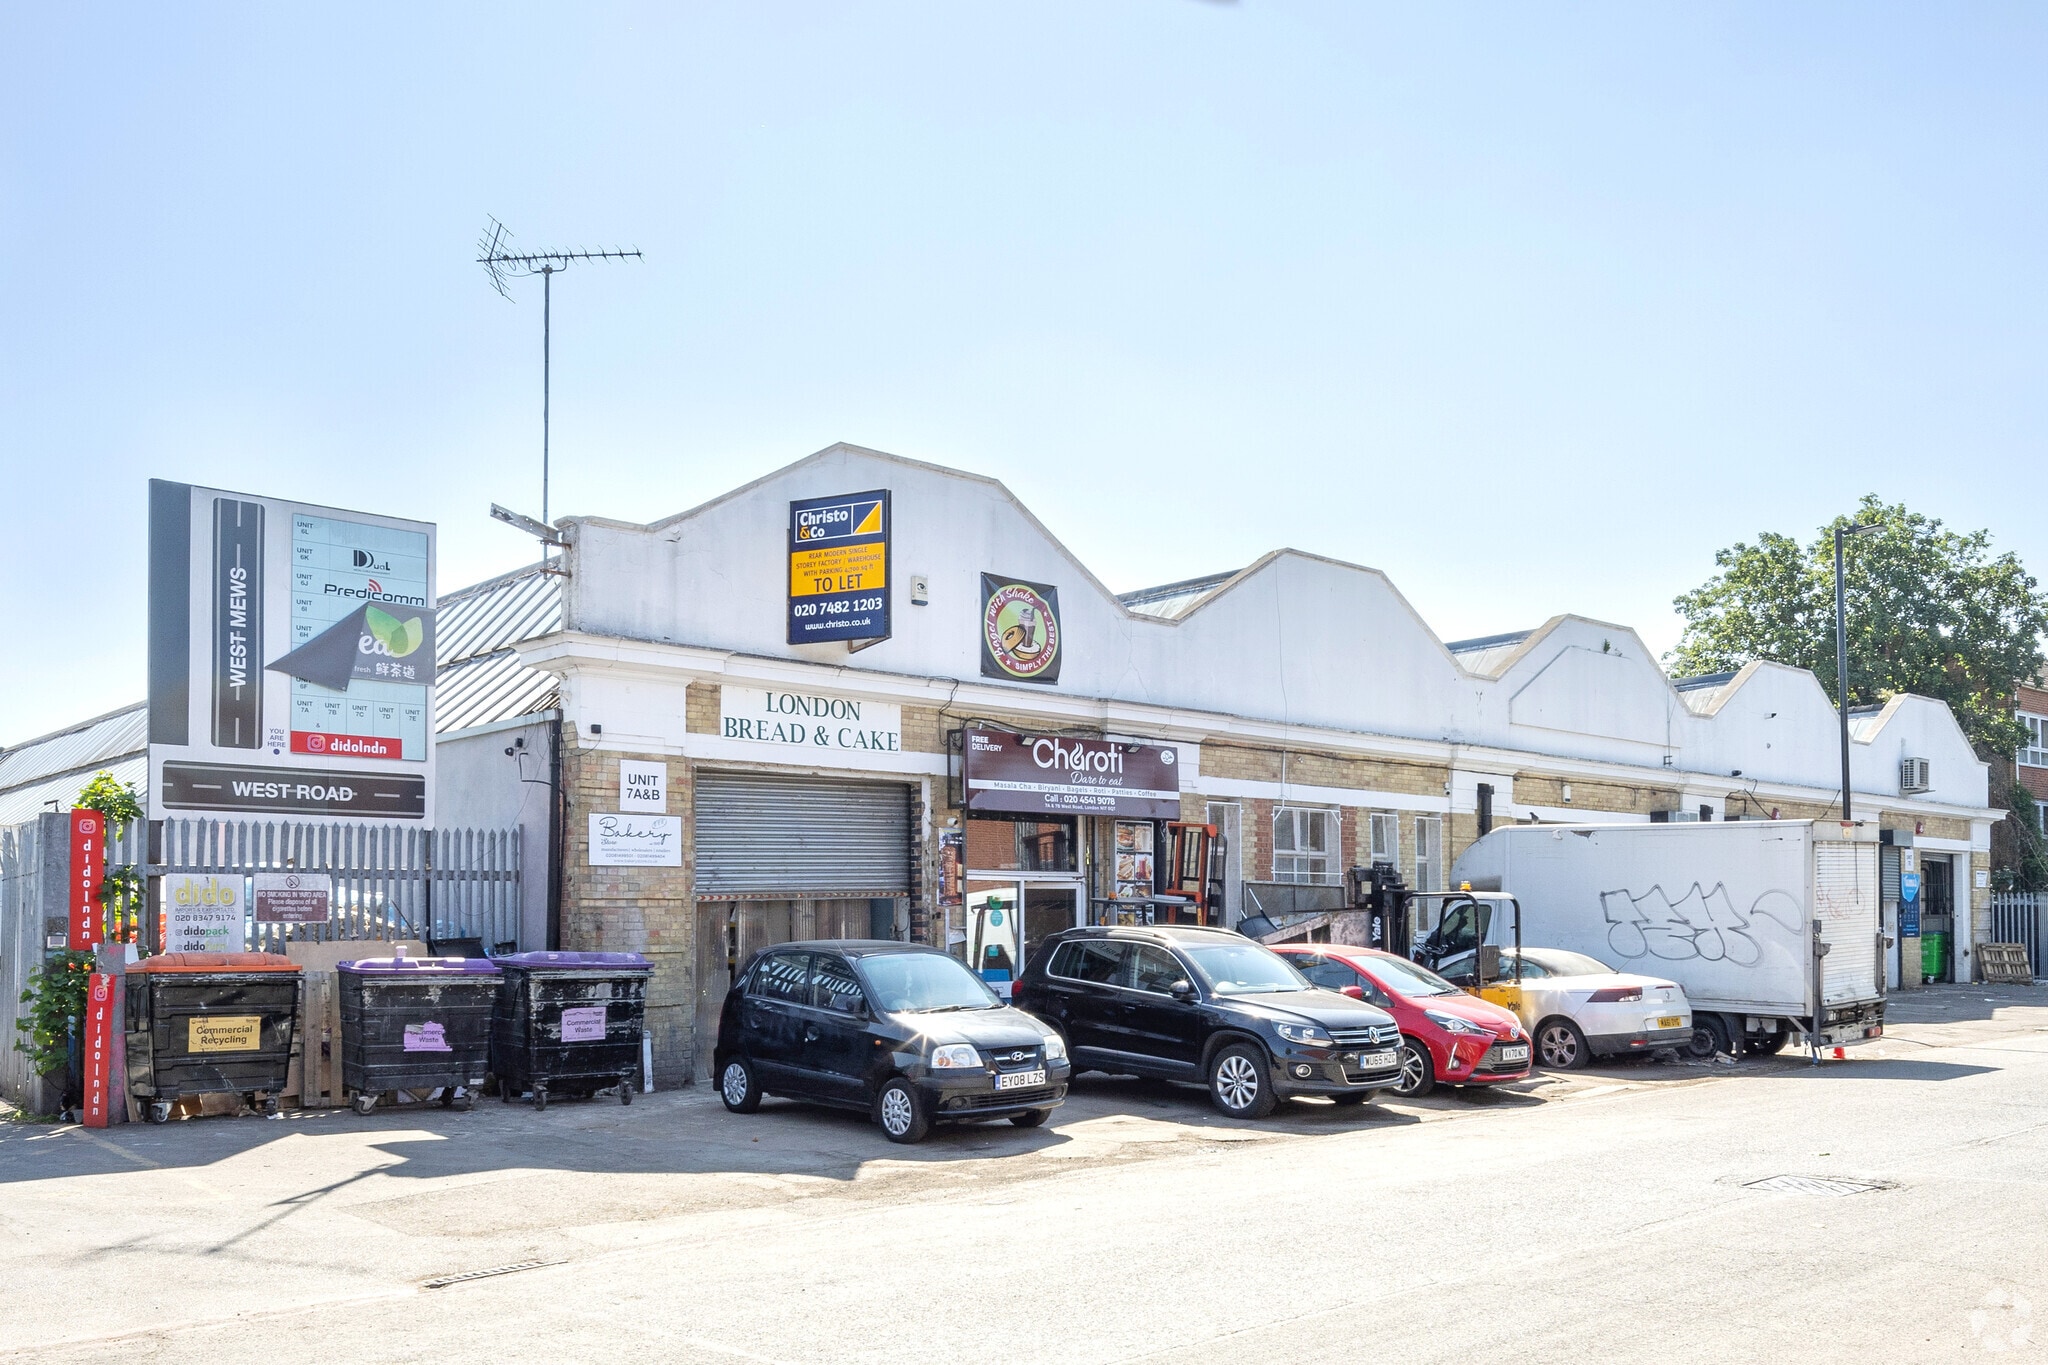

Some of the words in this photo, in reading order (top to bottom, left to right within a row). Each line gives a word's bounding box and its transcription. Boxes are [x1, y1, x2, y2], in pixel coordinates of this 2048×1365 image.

[297, 521, 314, 529] UNIT
[800, 510, 848, 526] Christo
[800, 526, 826, 539] &Co
[818, 559, 841, 567] FACTORY
[848, 554, 881, 563] WAREHOUSE
[824, 550, 846, 558] MODERN
[820, 567, 842, 575] PARKING
[814, 577, 833, 592] TO
[840, 574, 863, 590] LET
[230, 567, 246, 628] MEWS
[324, 584, 424, 606] Predicomm
[1006, 588, 1034, 604] Shake
[794, 604, 816, 617] 020
[820, 601, 850, 615] 7482
[853, 597, 883, 611] 1203
[805, 617, 871, 630] www.christo.co.uk
[1047, 620, 1055, 645] BEST
[230, 632, 246, 688] WEST
[1042, 646, 1053, 661] THE
[354, 665, 371, 673] fresh
[1015, 659, 1042, 671] SIMPLY
[766, 692, 862, 721] LONDON
[724, 717, 806, 743] BREAD
[813, 726, 830, 746] &
[838, 728, 899, 751] CAKE
[330, 738, 387, 754] didolndn
[971, 743, 1002, 752] DELIVERY
[1032, 738, 1123, 774] Charoti
[628, 773, 658, 786] UNIT
[1070, 771, 1097, 784] Dare
[1098, 775, 1107, 785] to
[1109, 777, 1123, 786] eat
[232, 781, 291, 798] WEST
[296, 784, 353, 801] ROAD
[626, 788, 660, 800] 7A&B
[1067, 786, 1088, 794] Bagels
[1044, 794, 1058, 803] Call
[1064, 795, 1078, 803] 020
[1080, 796, 1096, 804] 4541
[1098, 797, 1115, 806] 9078
[599, 816, 672, 845] Bakery
[82, 839, 91, 939] didolndn
[175, 878, 235, 906] dido
[184, 925, 229, 937] didopack
[1372, 916, 1381, 942] Yale
[1507, 1002, 1521, 1012] Yale
[196, 1025, 253, 1034] Commercial
[201, 1036, 247, 1045] Recycling
[93, 1007, 103, 1115] didolndn
[1002, 1075, 1025, 1087] EY08
[1028, 1073, 1044, 1084] LZS
